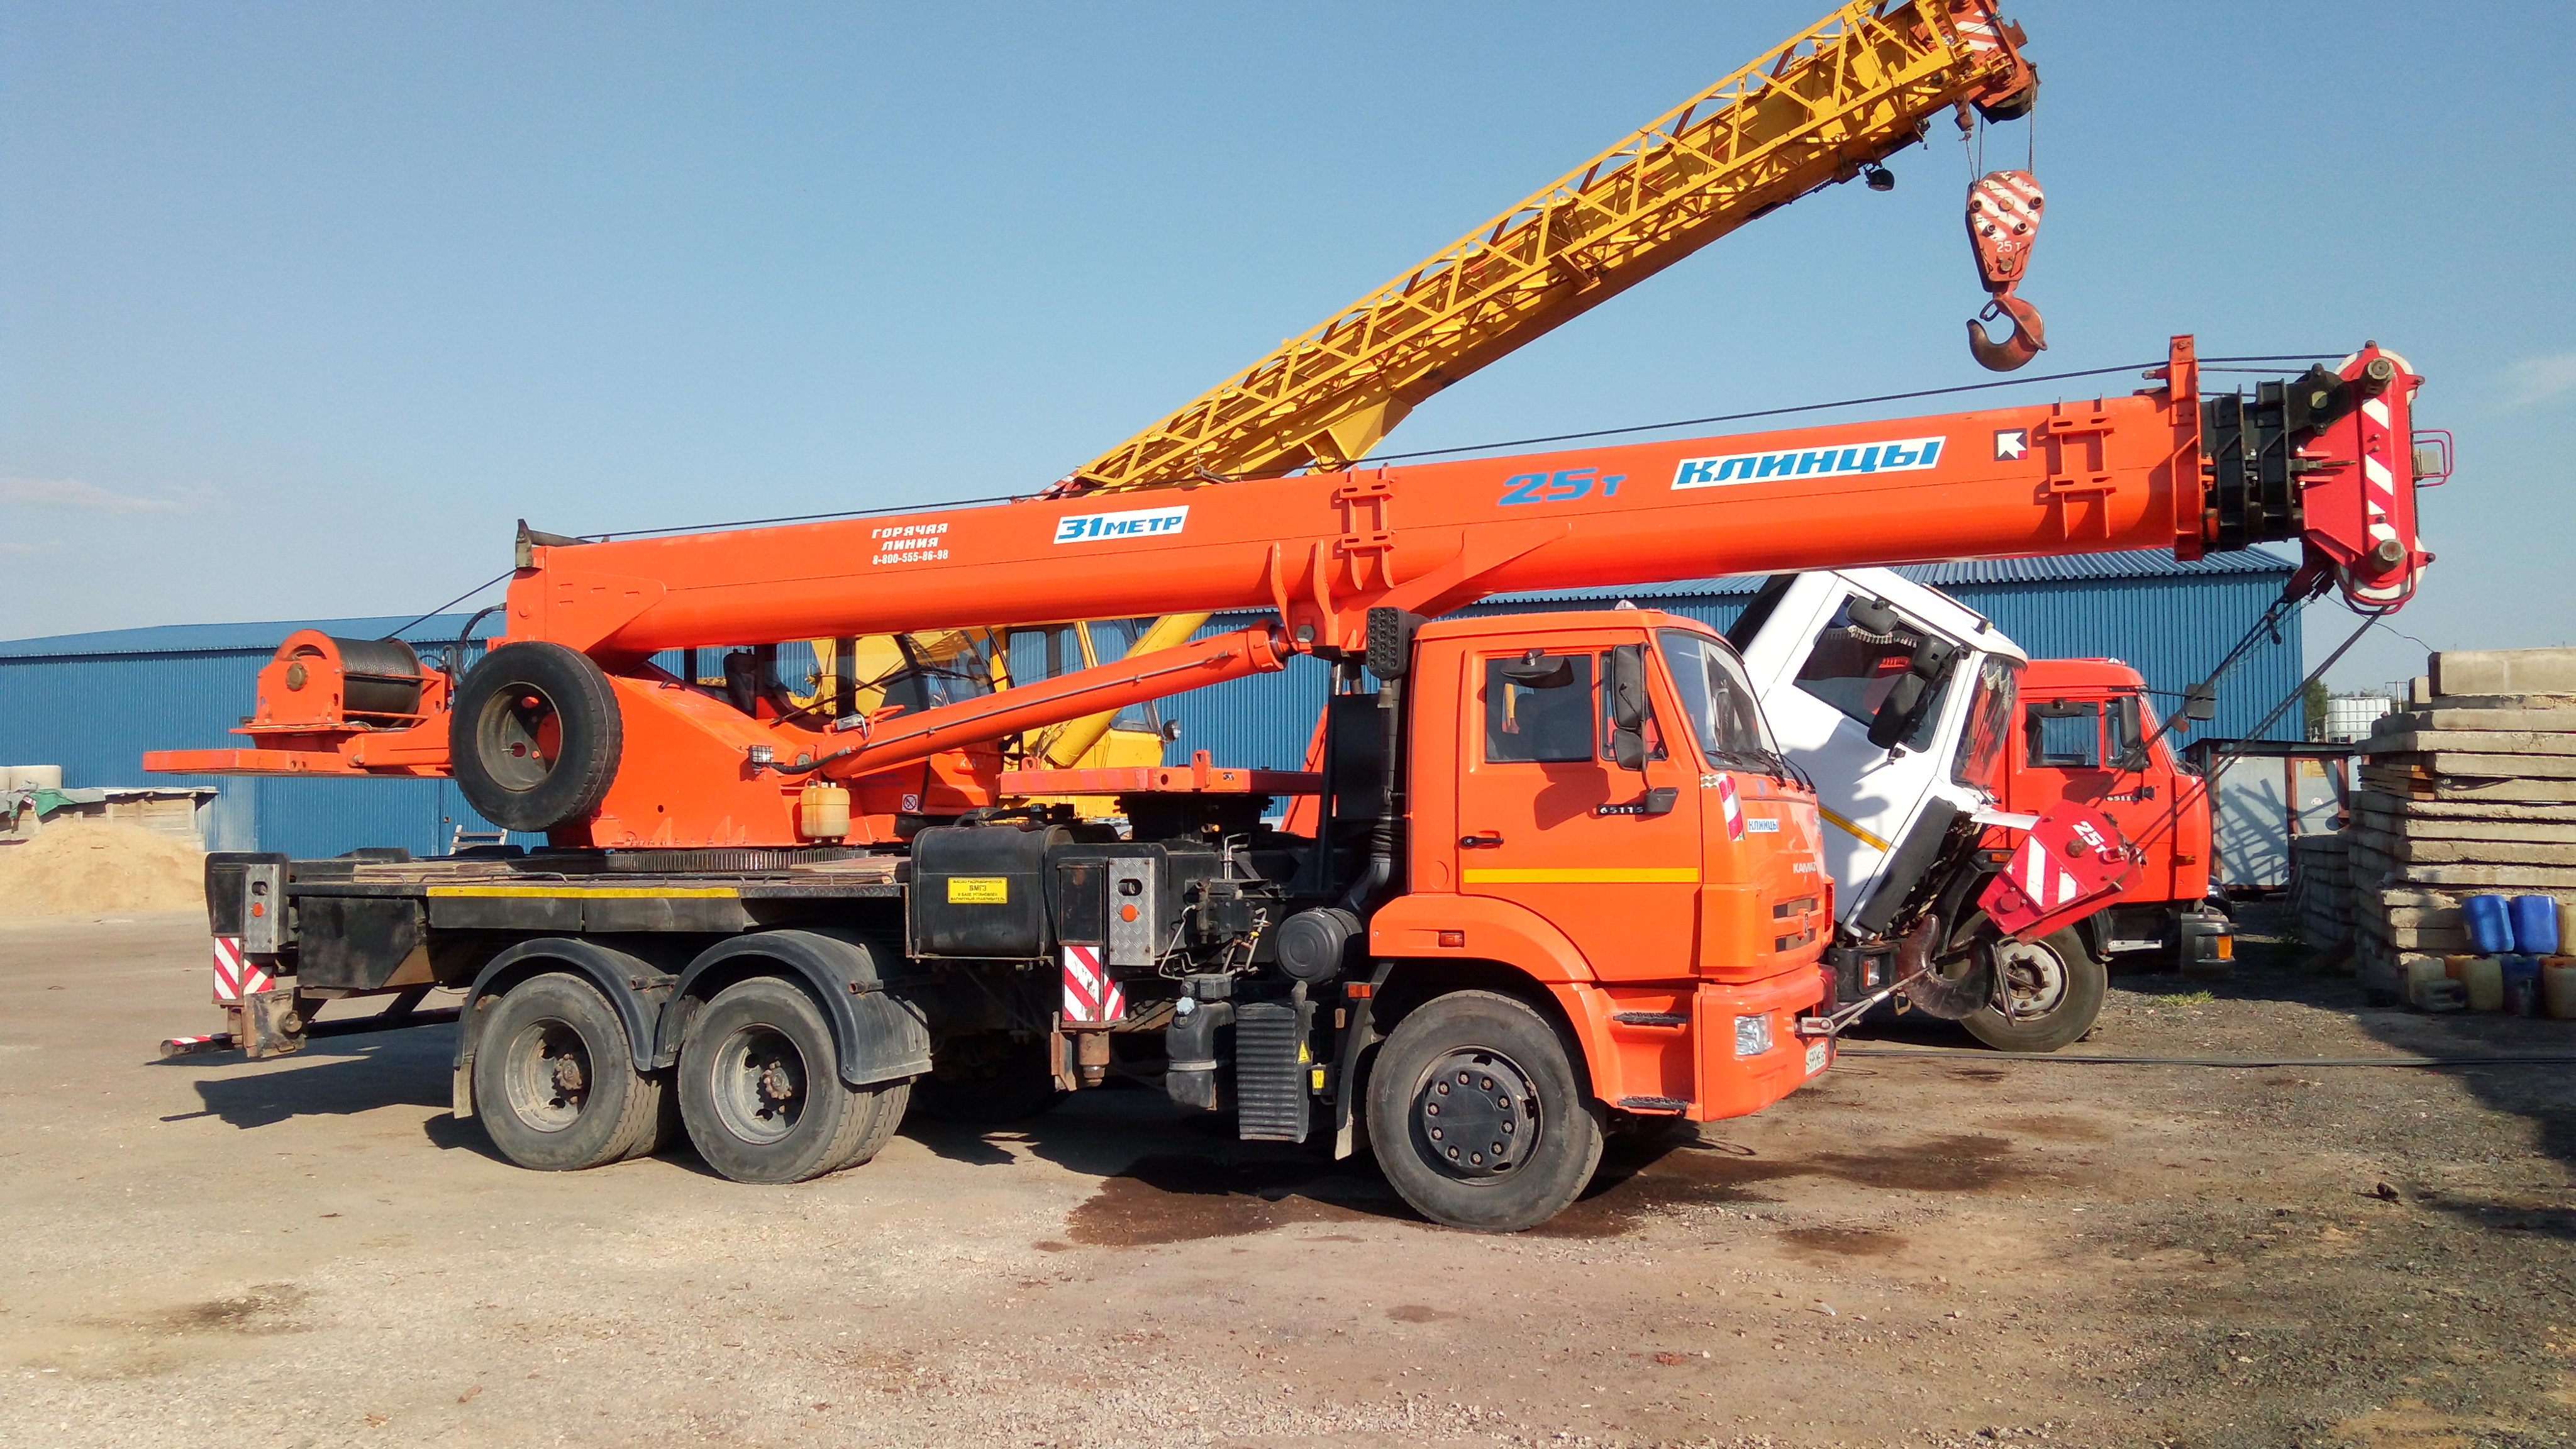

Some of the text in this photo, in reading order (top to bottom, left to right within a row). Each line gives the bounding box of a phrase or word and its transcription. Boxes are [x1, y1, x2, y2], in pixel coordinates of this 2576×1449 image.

[1996, 241, 2012, 252] 25
[1676, 441, 1941, 486] КЛИНЦЫ
[1497, 467, 1598, 506] 25
[871, 523, 948, 539] ГОРЯЧАЯ
[881, 536, 939, 551] ЛИНИЯ
[872, 549, 948, 565] 8-800-555-86-98
[1748, 820, 1779, 831] КЛИНЦЫ
